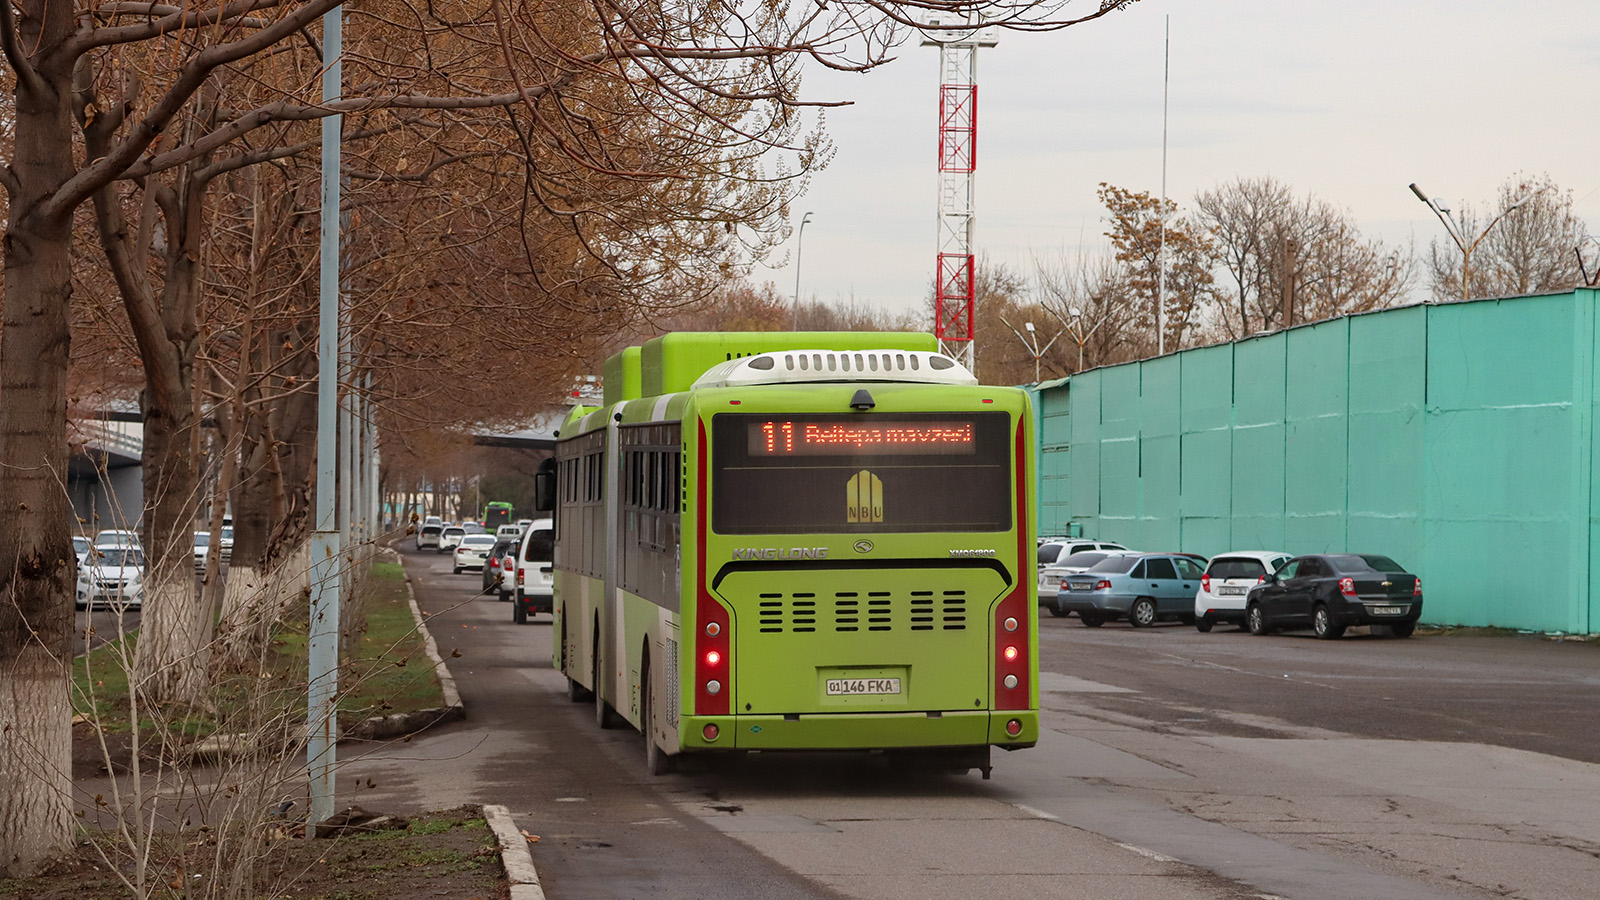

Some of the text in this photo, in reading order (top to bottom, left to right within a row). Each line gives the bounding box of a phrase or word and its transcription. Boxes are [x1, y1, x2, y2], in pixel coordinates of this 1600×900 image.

[763, 421, 793, 452] 11
[849, 506, 882, 519] NBU
[732, 547, 829, 560] KING LONG
[829, 680, 893, 693] 01 146 FKA
